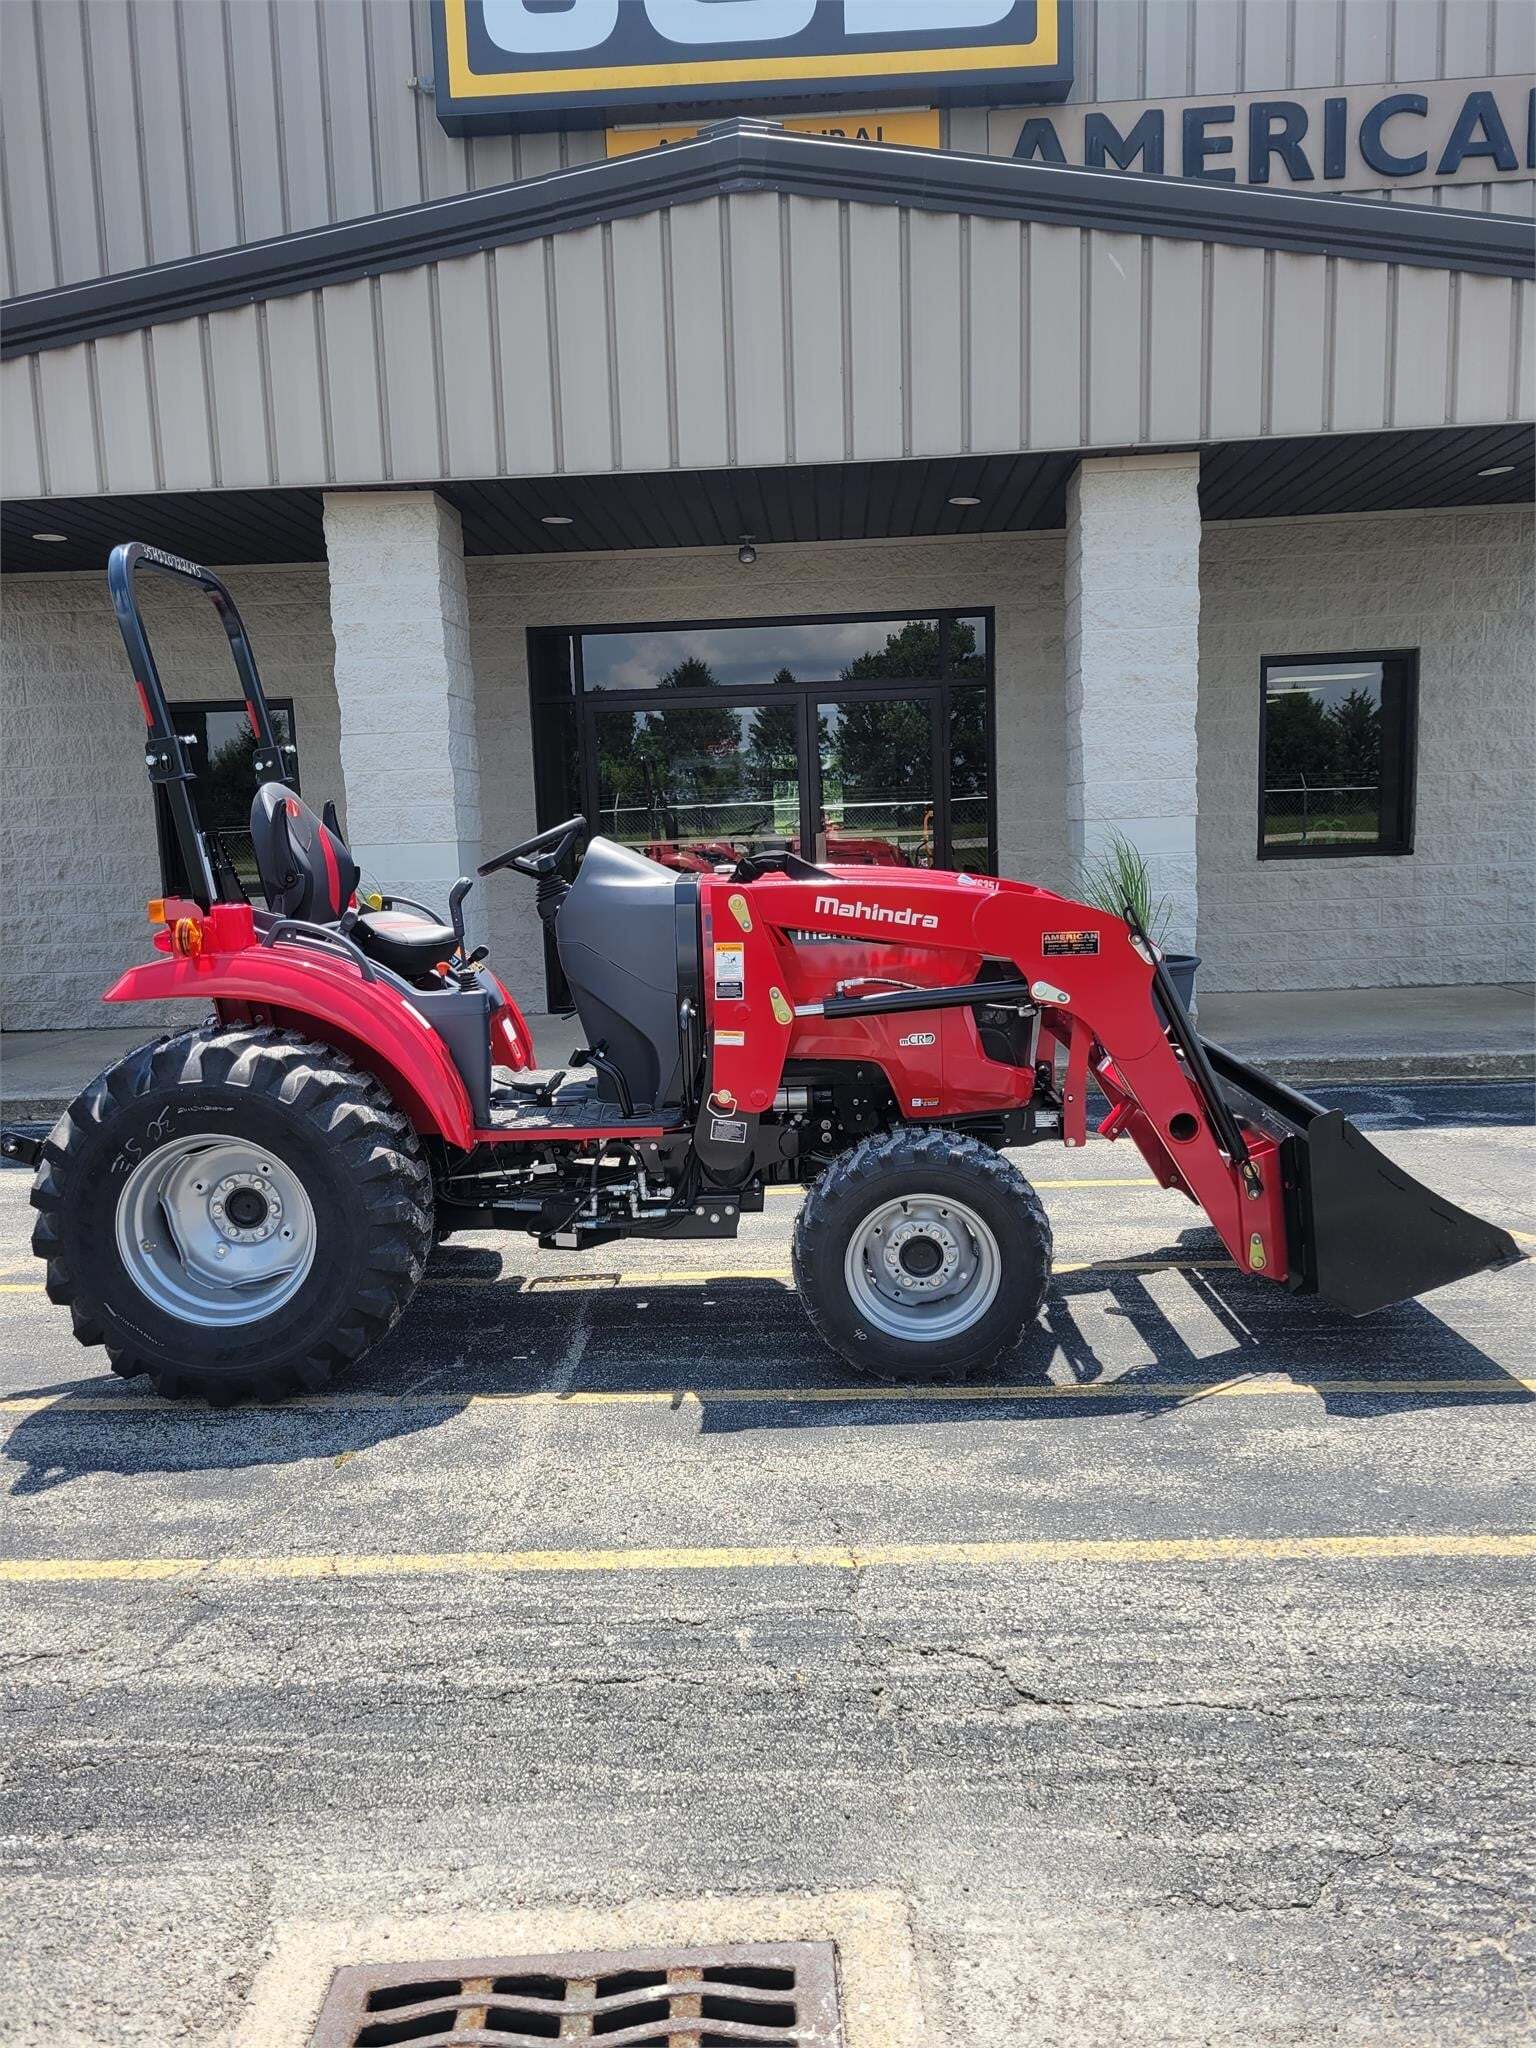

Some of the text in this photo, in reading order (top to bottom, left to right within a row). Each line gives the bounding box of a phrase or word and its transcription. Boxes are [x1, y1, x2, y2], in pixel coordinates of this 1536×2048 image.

[1012, 88, 1536, 184] AMERICA
[815, 896, 939, 928] Mahindra
[1044, 933, 1098, 941] AMERICAN
